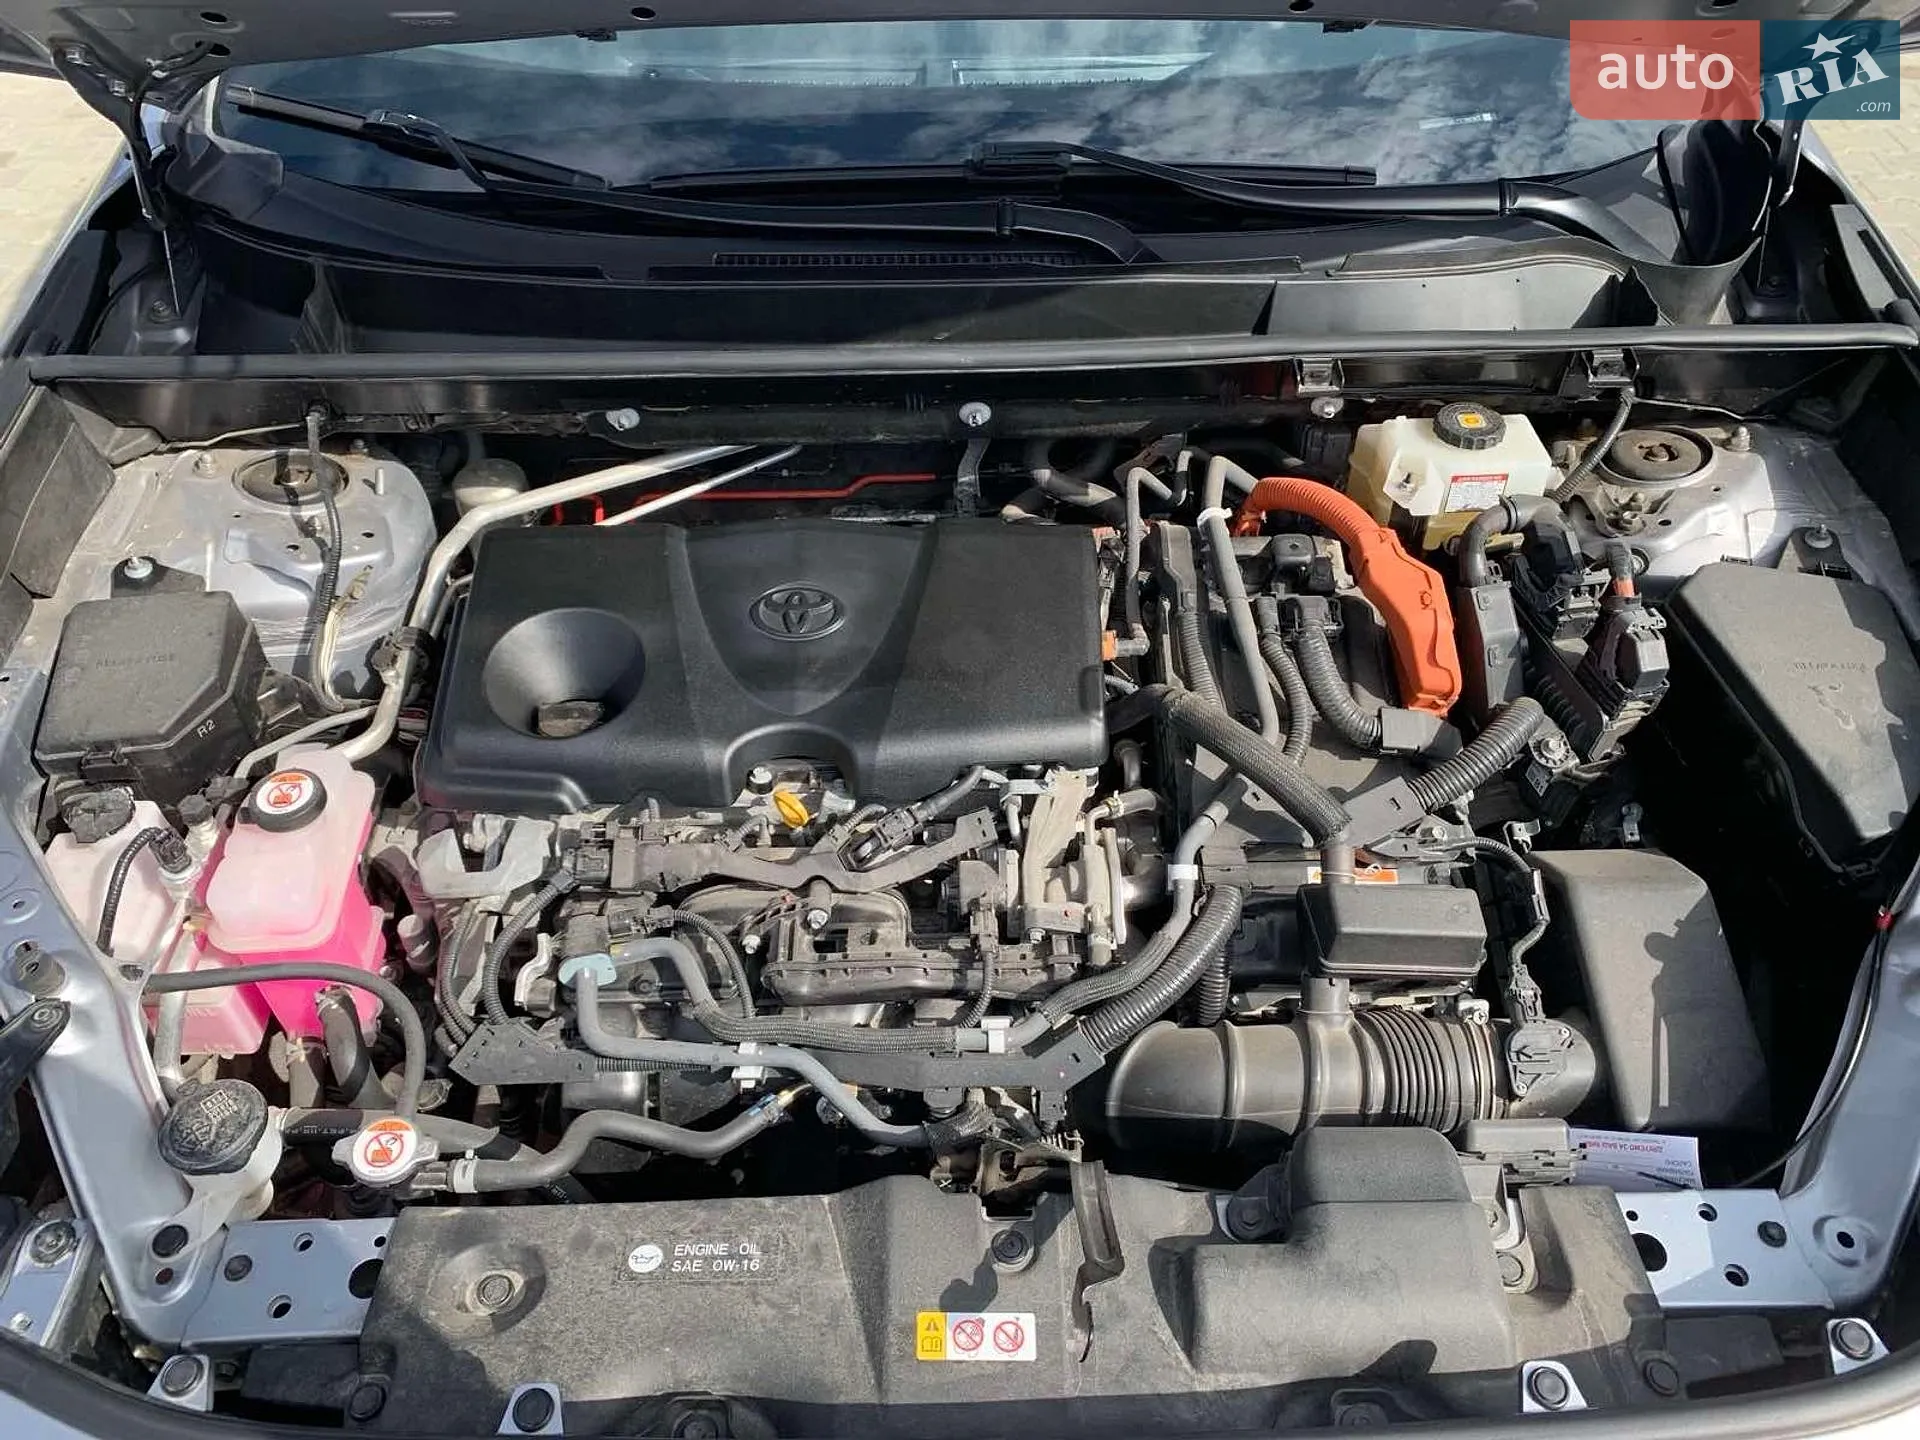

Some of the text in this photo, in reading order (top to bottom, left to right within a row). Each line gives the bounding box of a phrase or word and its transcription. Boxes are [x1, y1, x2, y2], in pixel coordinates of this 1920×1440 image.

[196, 719, 217, 738] R2
[674, 1243, 762, 1257] ENGINE OIL
[671, 1260, 703, 1272] SAE
